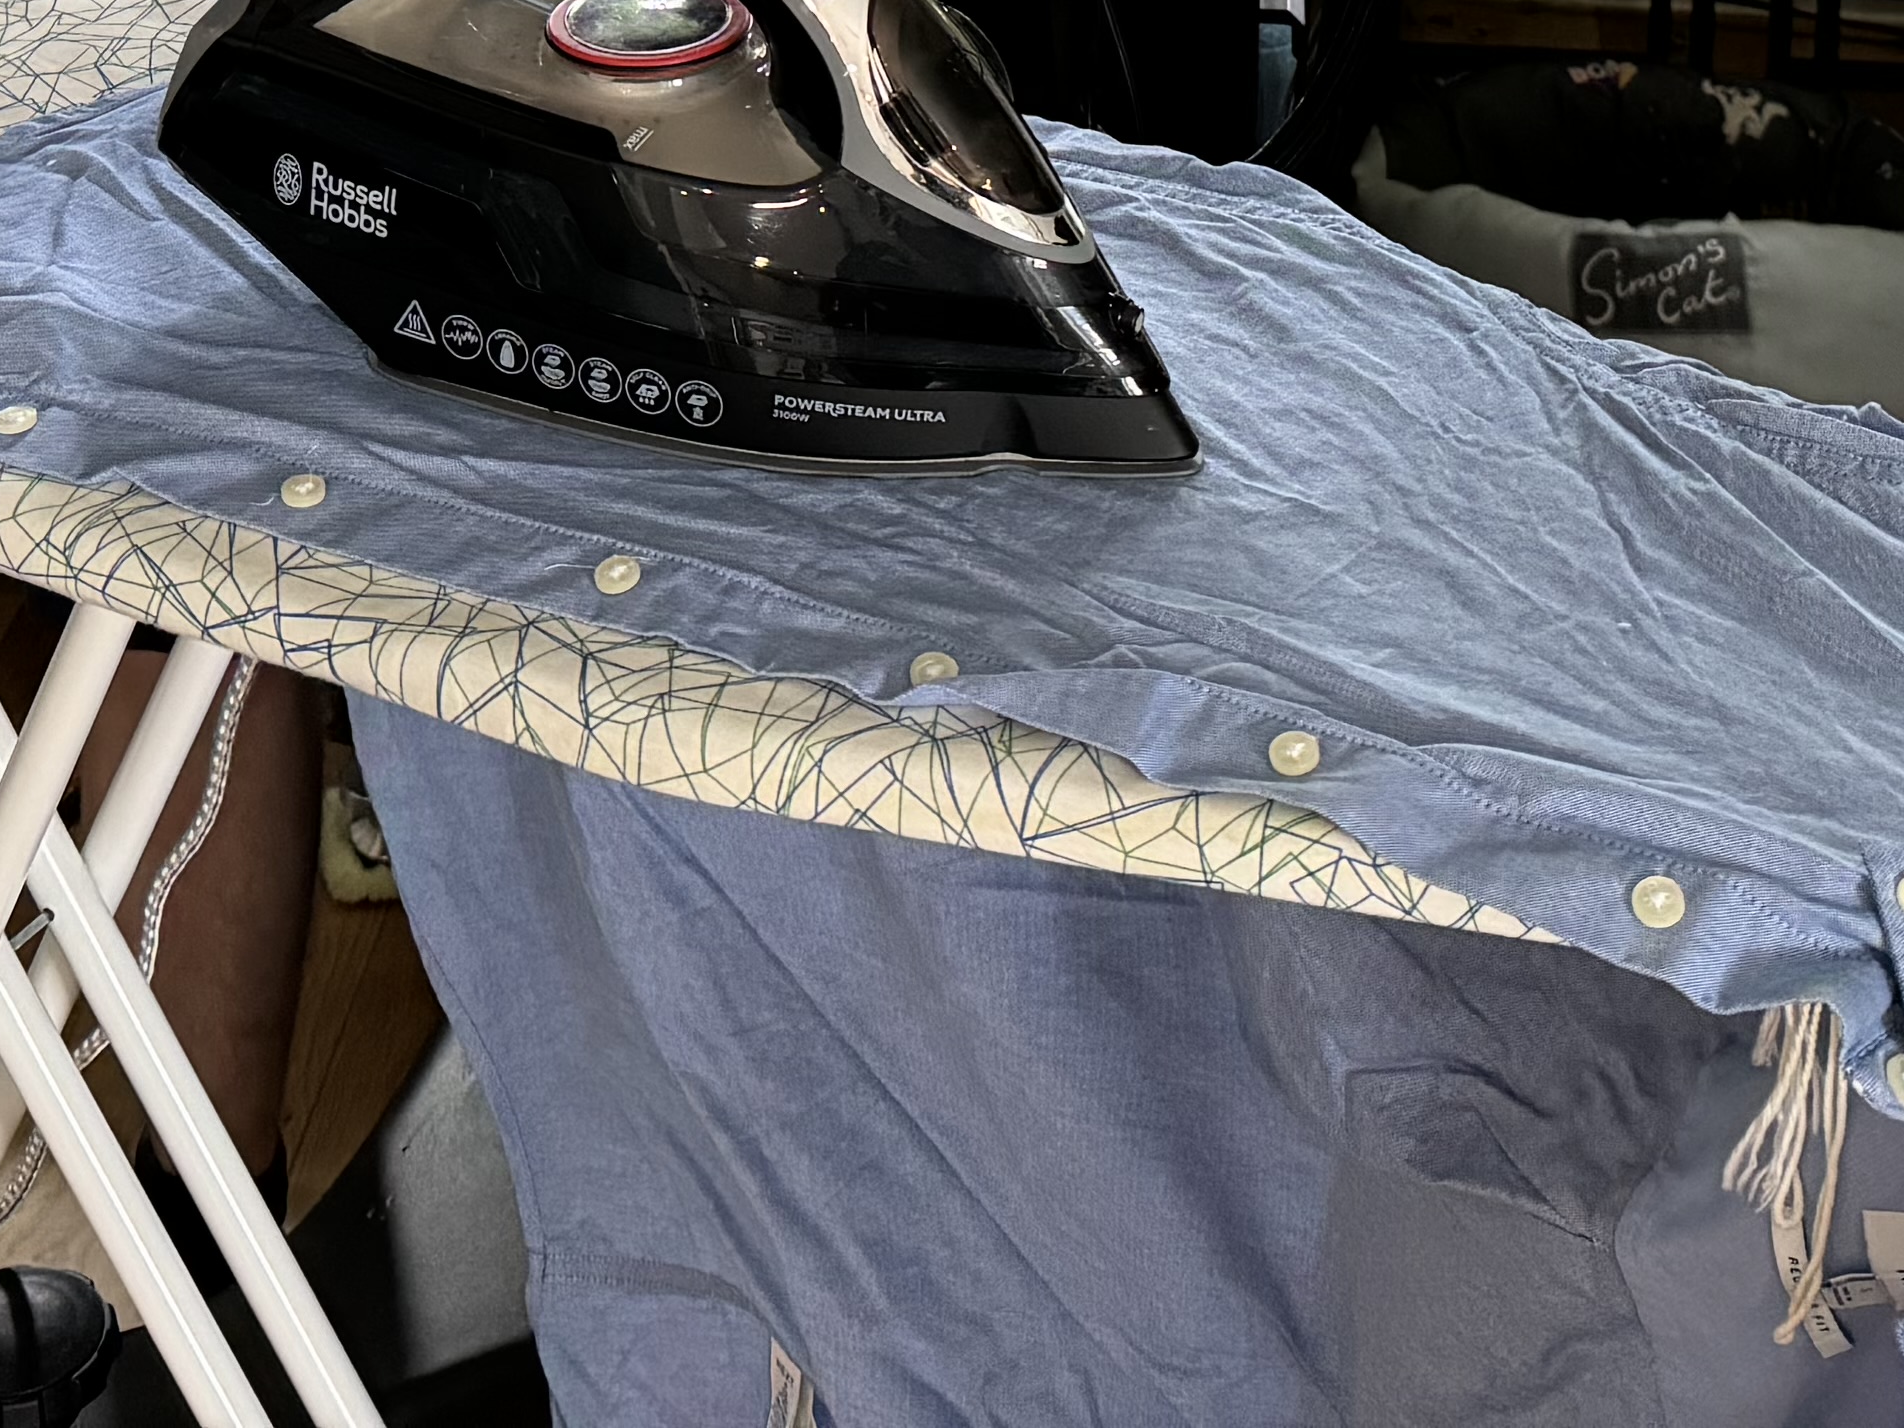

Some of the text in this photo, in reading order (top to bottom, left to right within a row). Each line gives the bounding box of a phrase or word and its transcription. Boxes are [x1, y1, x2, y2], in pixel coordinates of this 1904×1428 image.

[310, 188, 388, 238] Hobbs
[312, 161, 397, 216] Russell
[1581, 238, 1726, 325] Simon's
[1657, 269, 1726, 324] Cat
[772, 409, 810, 423] 3100W
[774, 394, 946, 423] POWERSTEAM ULTRA
[1812, 1315, 1831, 1332] FIT
